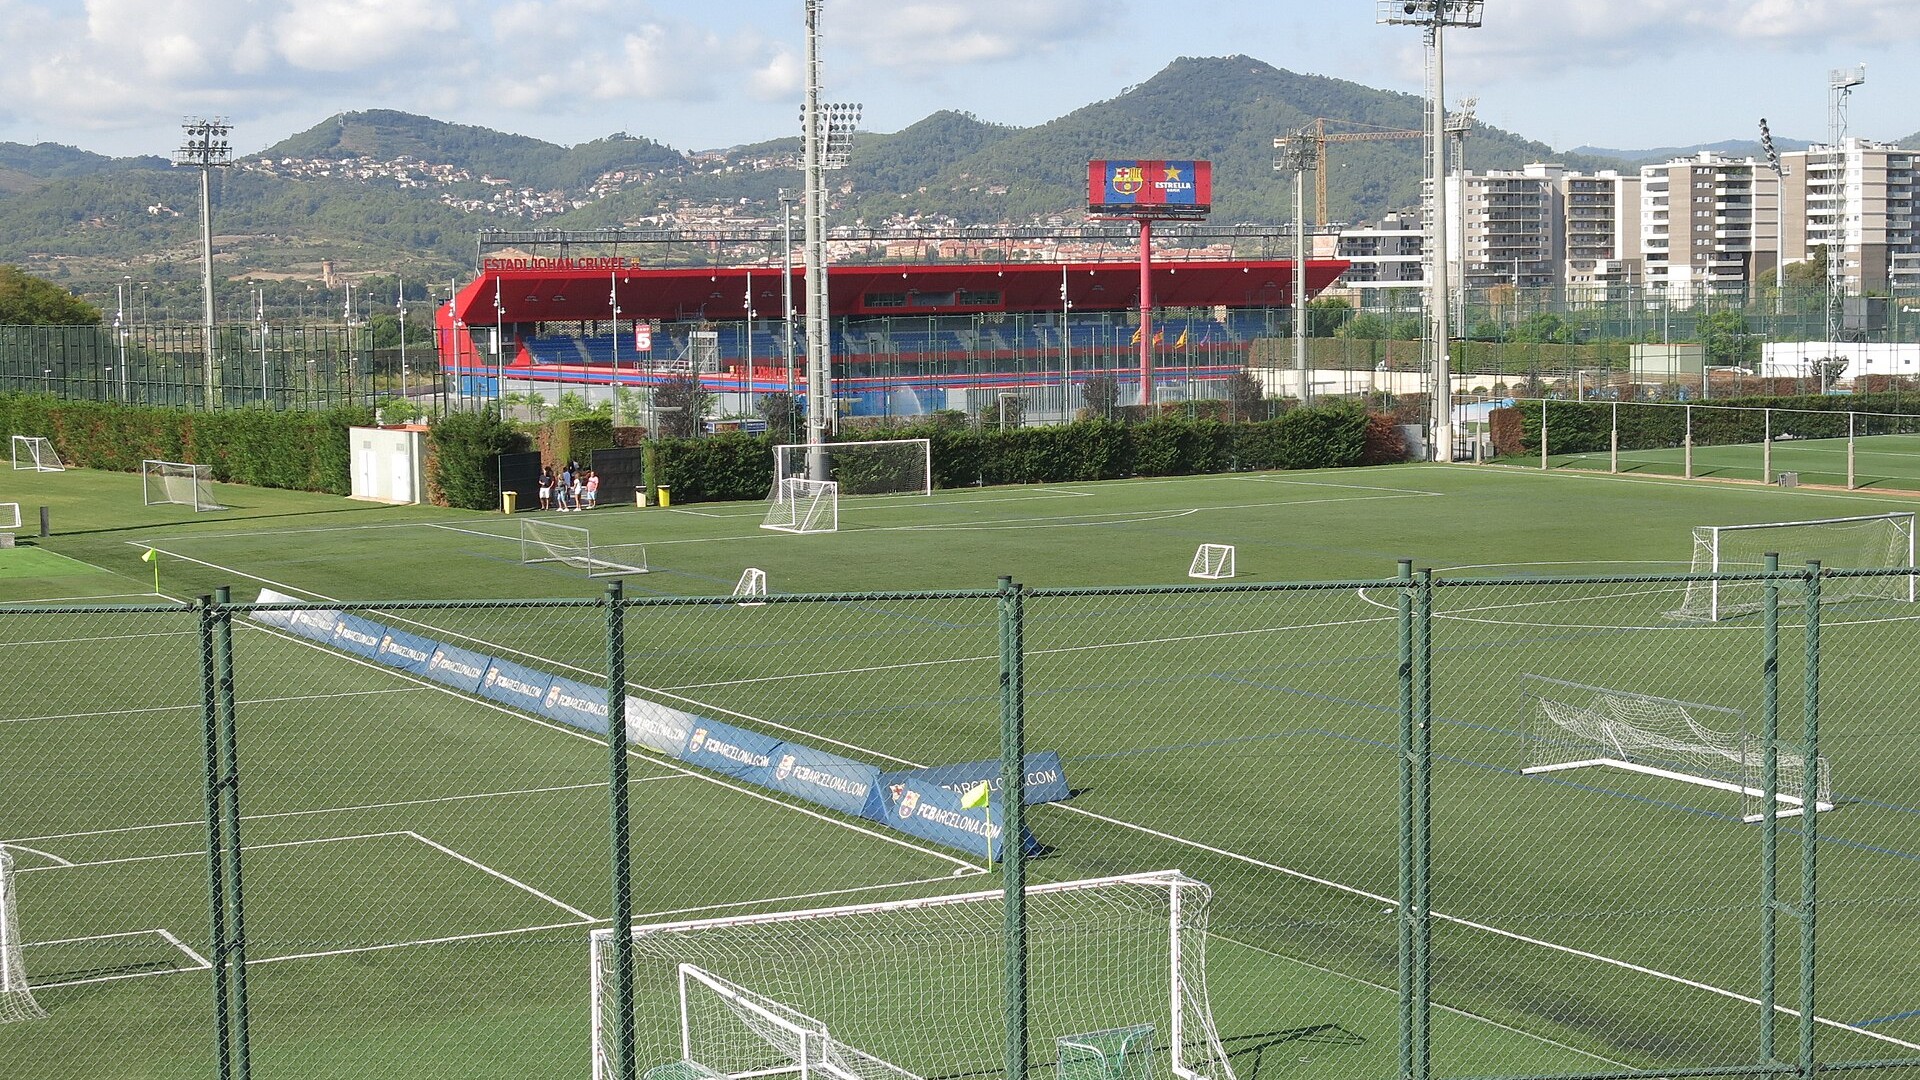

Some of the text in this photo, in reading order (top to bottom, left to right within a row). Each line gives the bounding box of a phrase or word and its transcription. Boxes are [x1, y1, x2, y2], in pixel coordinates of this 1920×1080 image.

[484, 258, 527, 270] ESTADI
[531, 258, 574, 270] JOHAN
[637, 333, 650, 348] 5
[557, 694, 608, 717] FCBARCELONA.CO
[704, 738, 770, 767] FCBARCELONA.COM
[792, 765, 867, 797] FCBARCELONA.COM
[917, 803, 1002, 839] FCBARCELONA.COM
